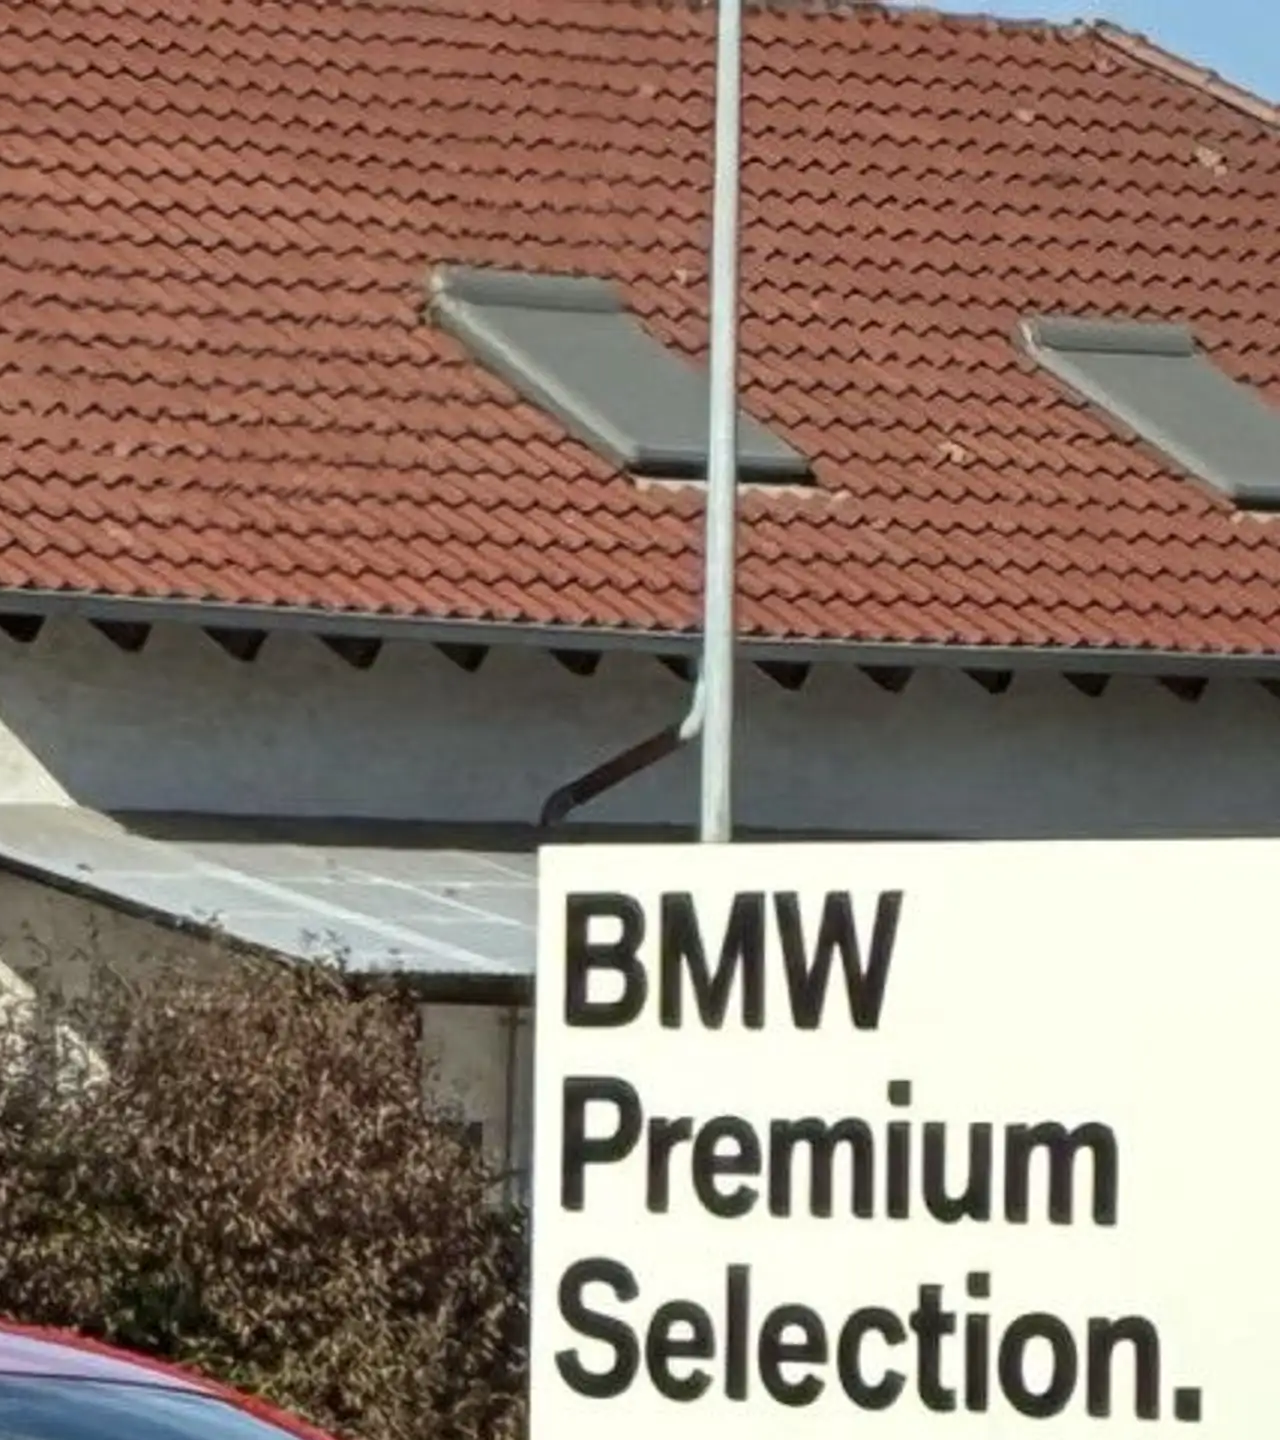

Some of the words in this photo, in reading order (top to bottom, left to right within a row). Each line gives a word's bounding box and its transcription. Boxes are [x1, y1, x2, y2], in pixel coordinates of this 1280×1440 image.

[563, 888, 904, 1031] BMW
[559, 1075, 1119, 1227] Premium
[554, 1256, 1203, 1423] Selection.
